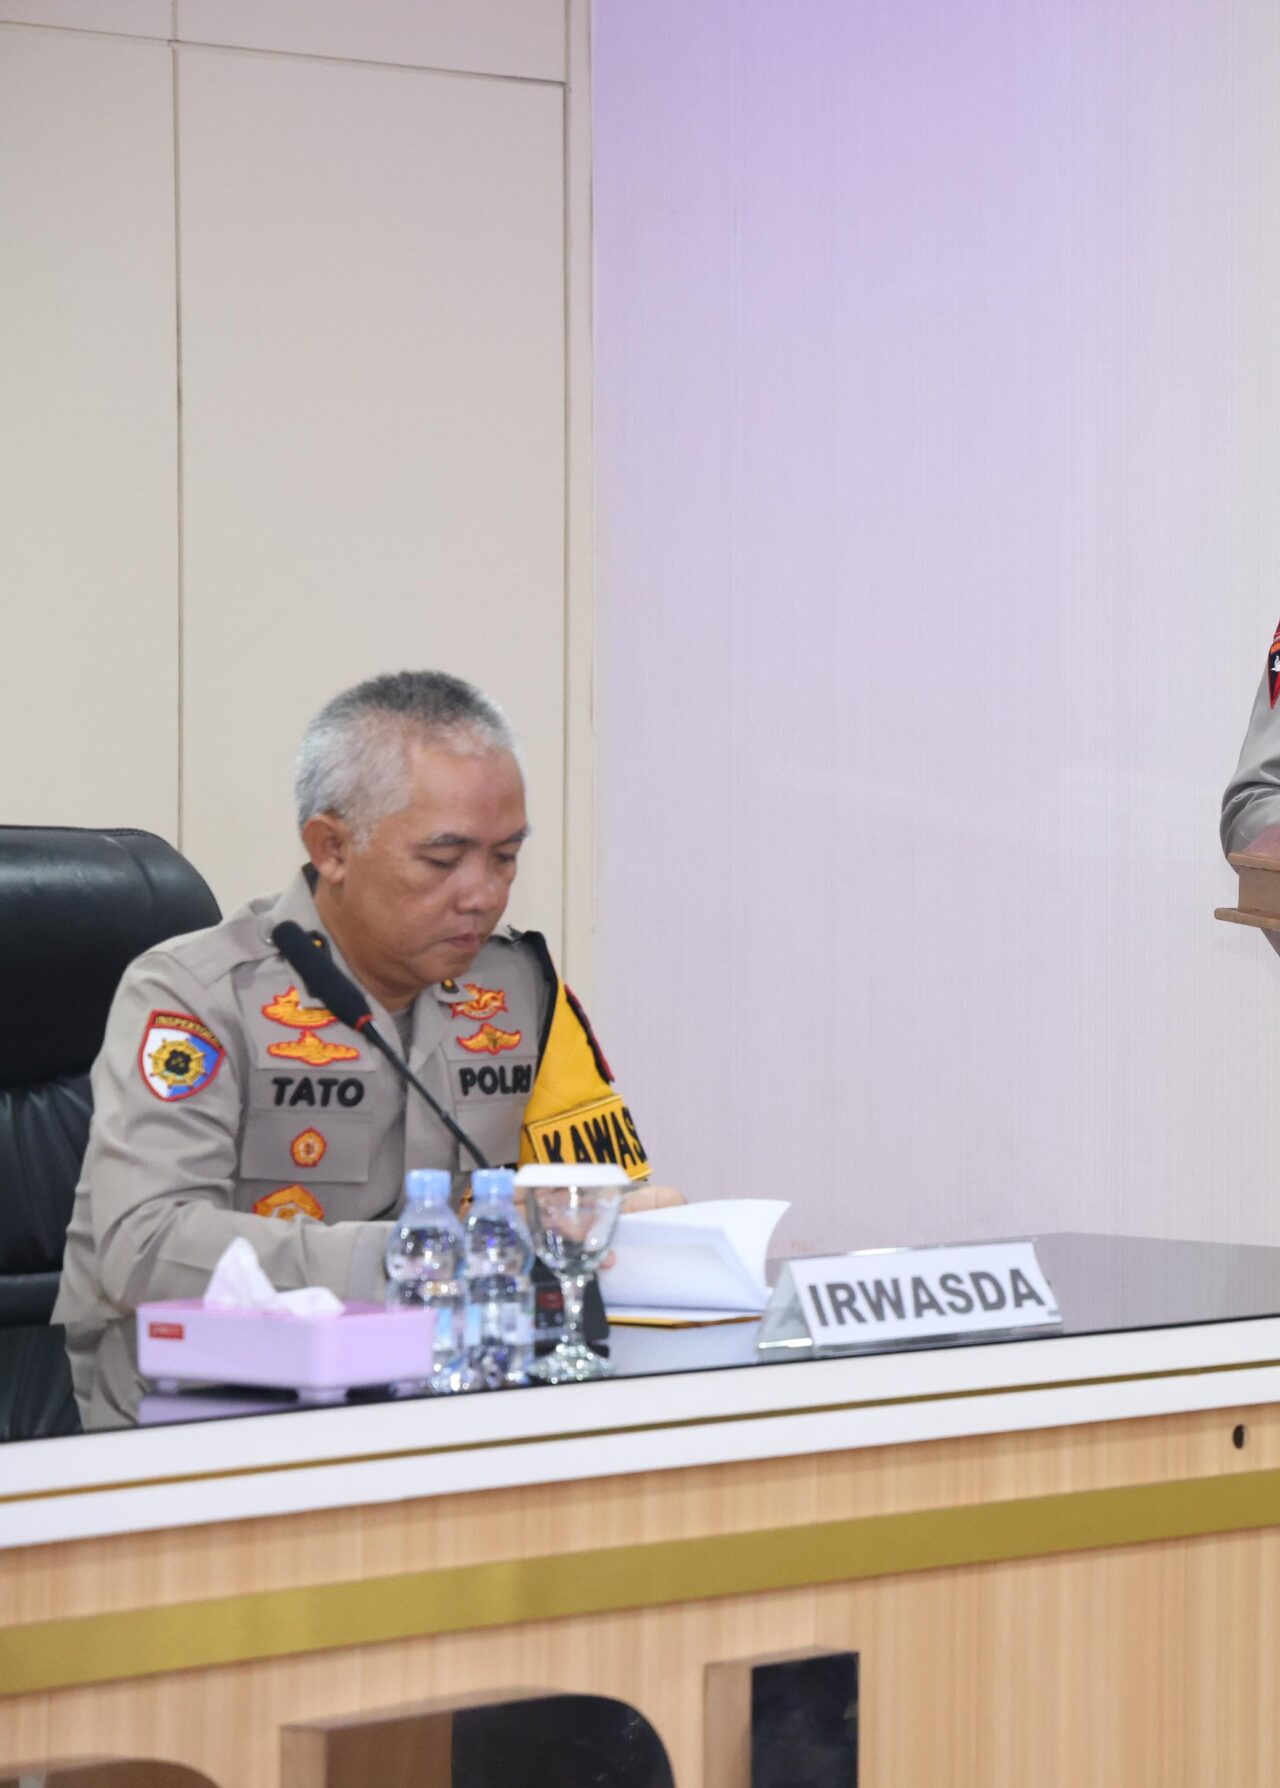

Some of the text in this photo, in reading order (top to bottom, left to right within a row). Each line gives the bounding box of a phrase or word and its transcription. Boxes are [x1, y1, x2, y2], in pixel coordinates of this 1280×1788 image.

[272, 1076, 365, 1108] TATO
[459, 1064, 532, 1096] POLRI
[805, 1268, 1045, 1327] IRWASDA
